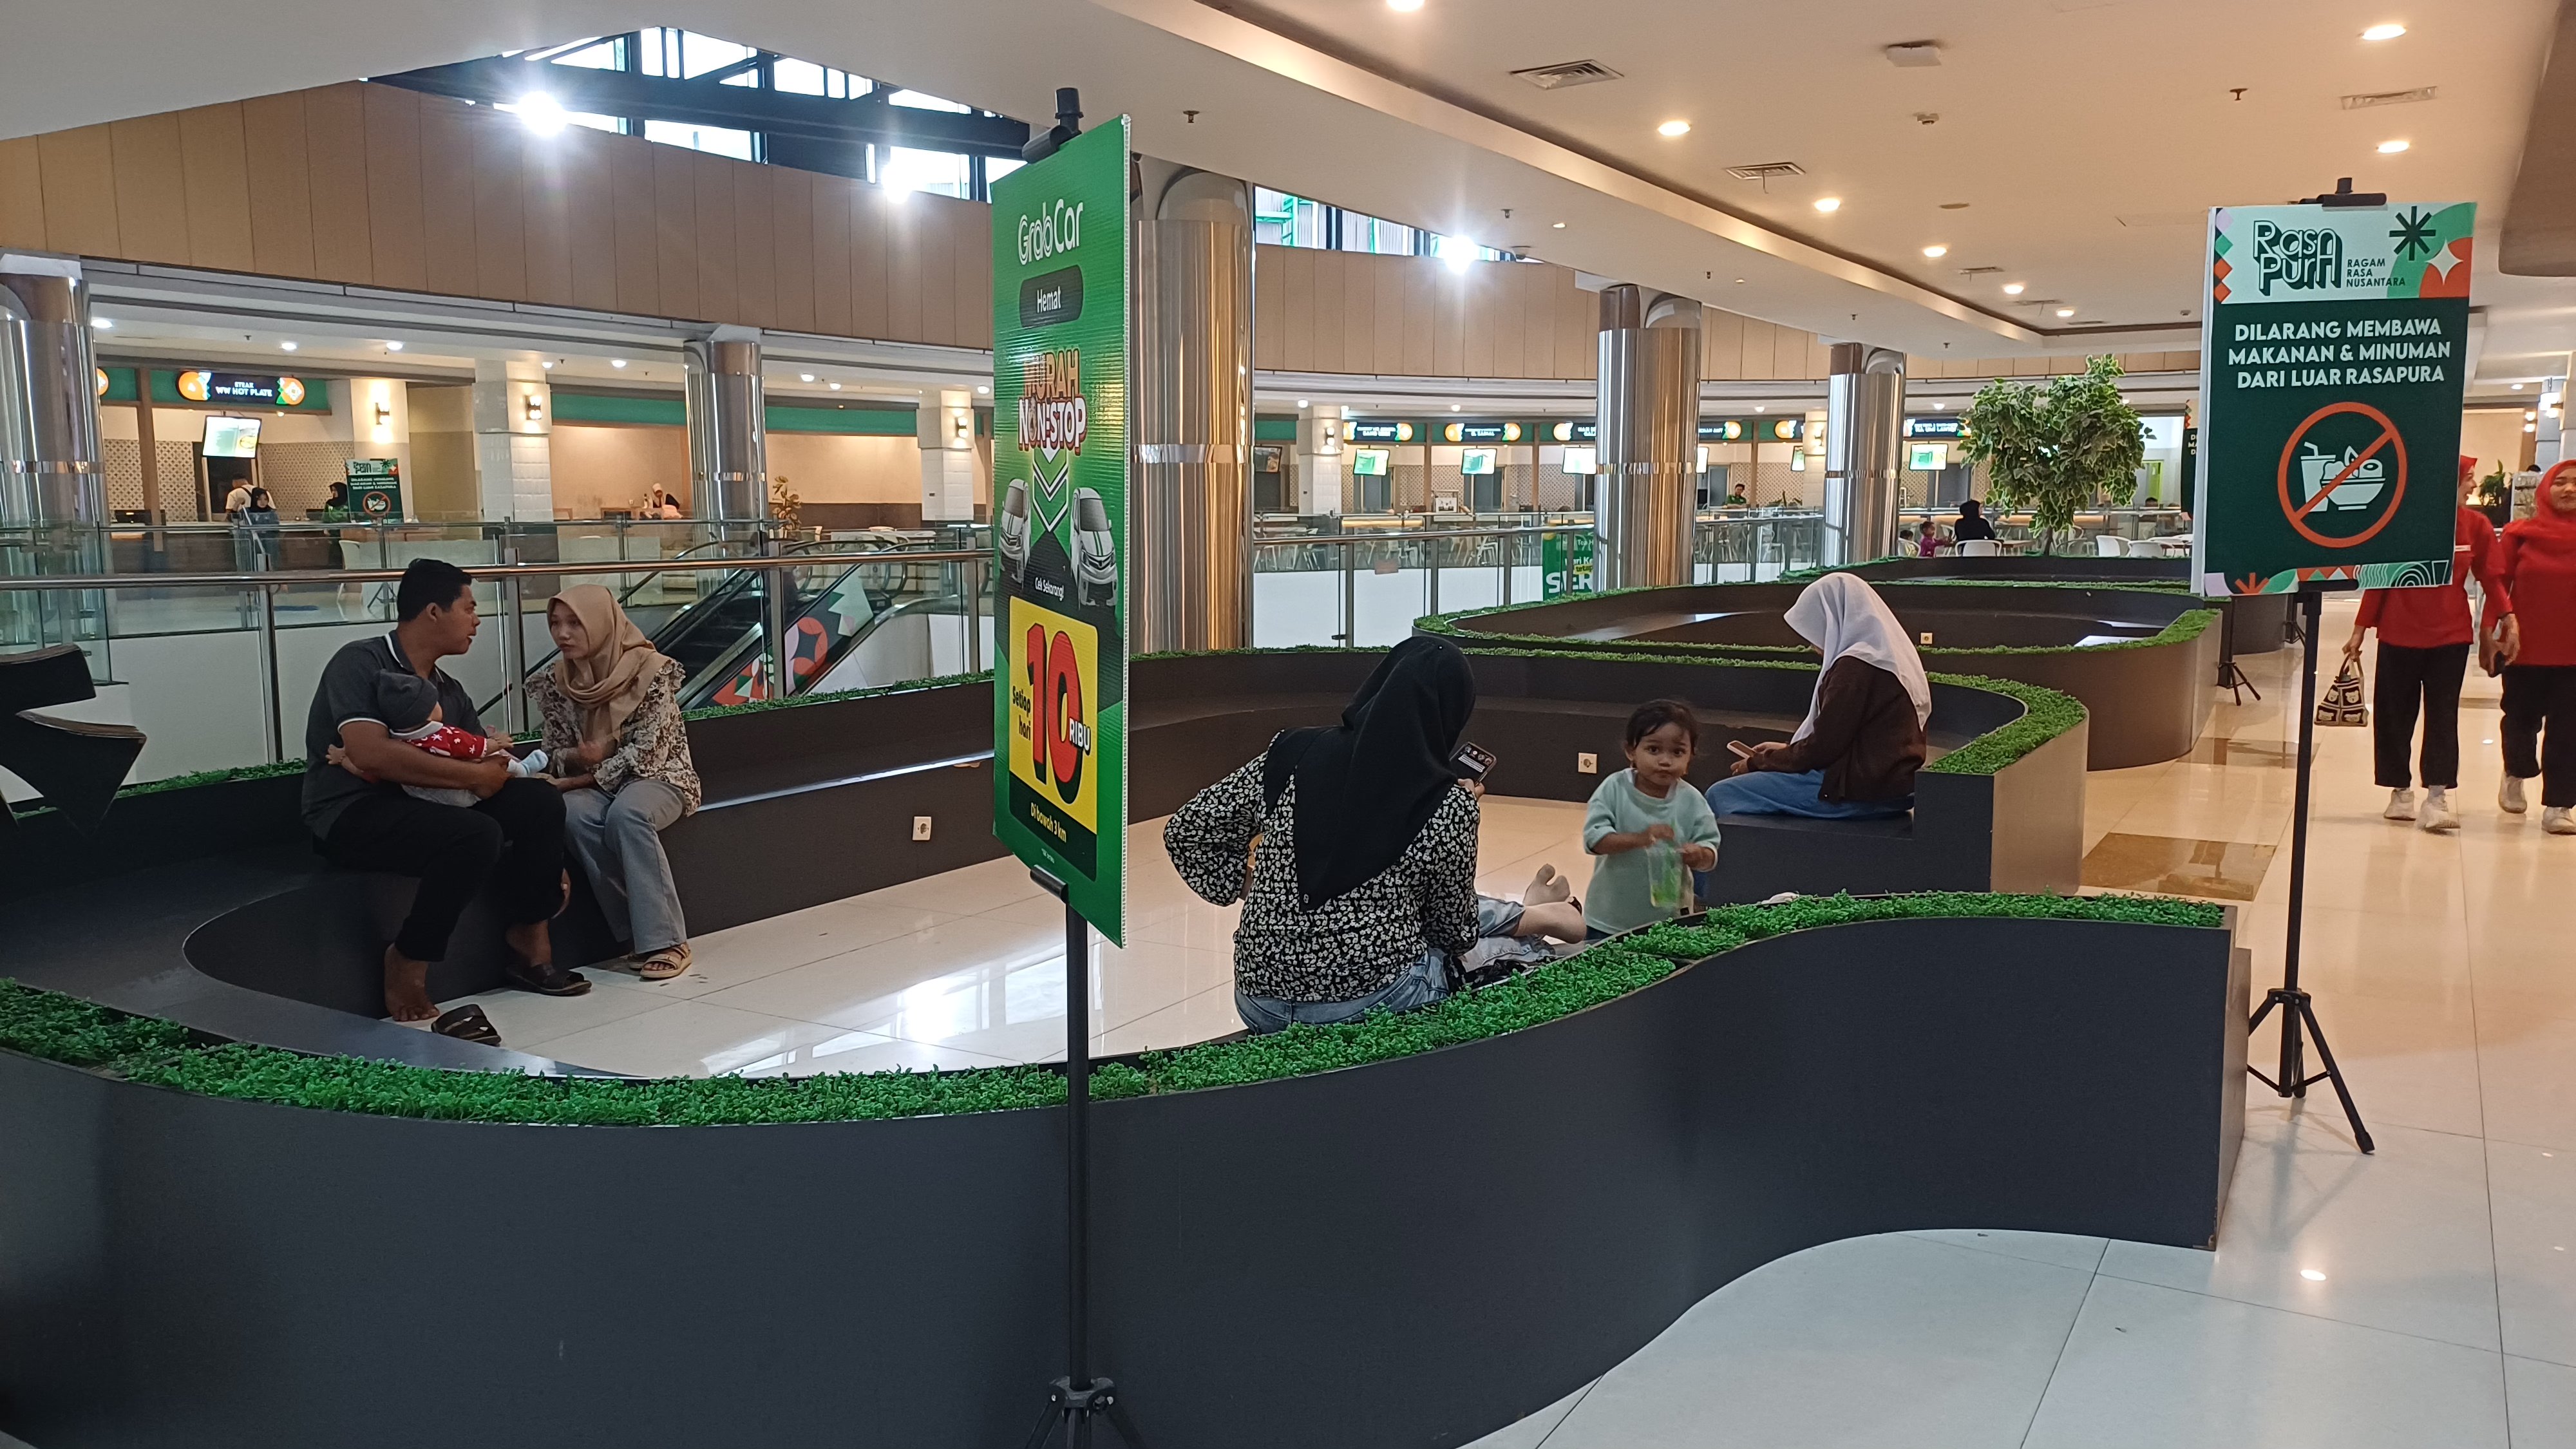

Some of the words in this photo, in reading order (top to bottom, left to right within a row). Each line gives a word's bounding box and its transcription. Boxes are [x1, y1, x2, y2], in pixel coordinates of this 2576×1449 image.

[1018, 198, 1083, 265] GrabCar
[2347, 258, 2385, 268] RAGAM
[2347, 268, 2372, 278] RASA
[2346, 277, 2406, 288] NUSANTARA
[1037, 285, 1061, 314] Hemat
[2235, 321, 2342, 341] DILARANG
[2347, 318, 2441, 337] MEMBAWA
[2228, 345, 2334, 365] MAKANAN
[2340, 344, 2354, 362] &
[2359, 341, 2450, 361] MINUMAN
[2237, 370, 2285, 389] DARI
[2291, 368, 2342, 386] LUAR
[2346, 365, 2445, 384] RASAPURA
[250, 388, 272, 397] PLATE
[1043, 579, 1064, 601] Sekarang!
[1012, 685, 1031, 718] Setiap
[1027, 622, 1082, 804] 10
[1018, 714, 1031, 741] hari
[1068, 717, 1092, 753] RIBU
[1030, 802, 1036, 819] Di
[1036, 805, 1053, 833] bawah
[1054, 819, 1057, 835] 3
[1057, 821, 1066, 843] km
